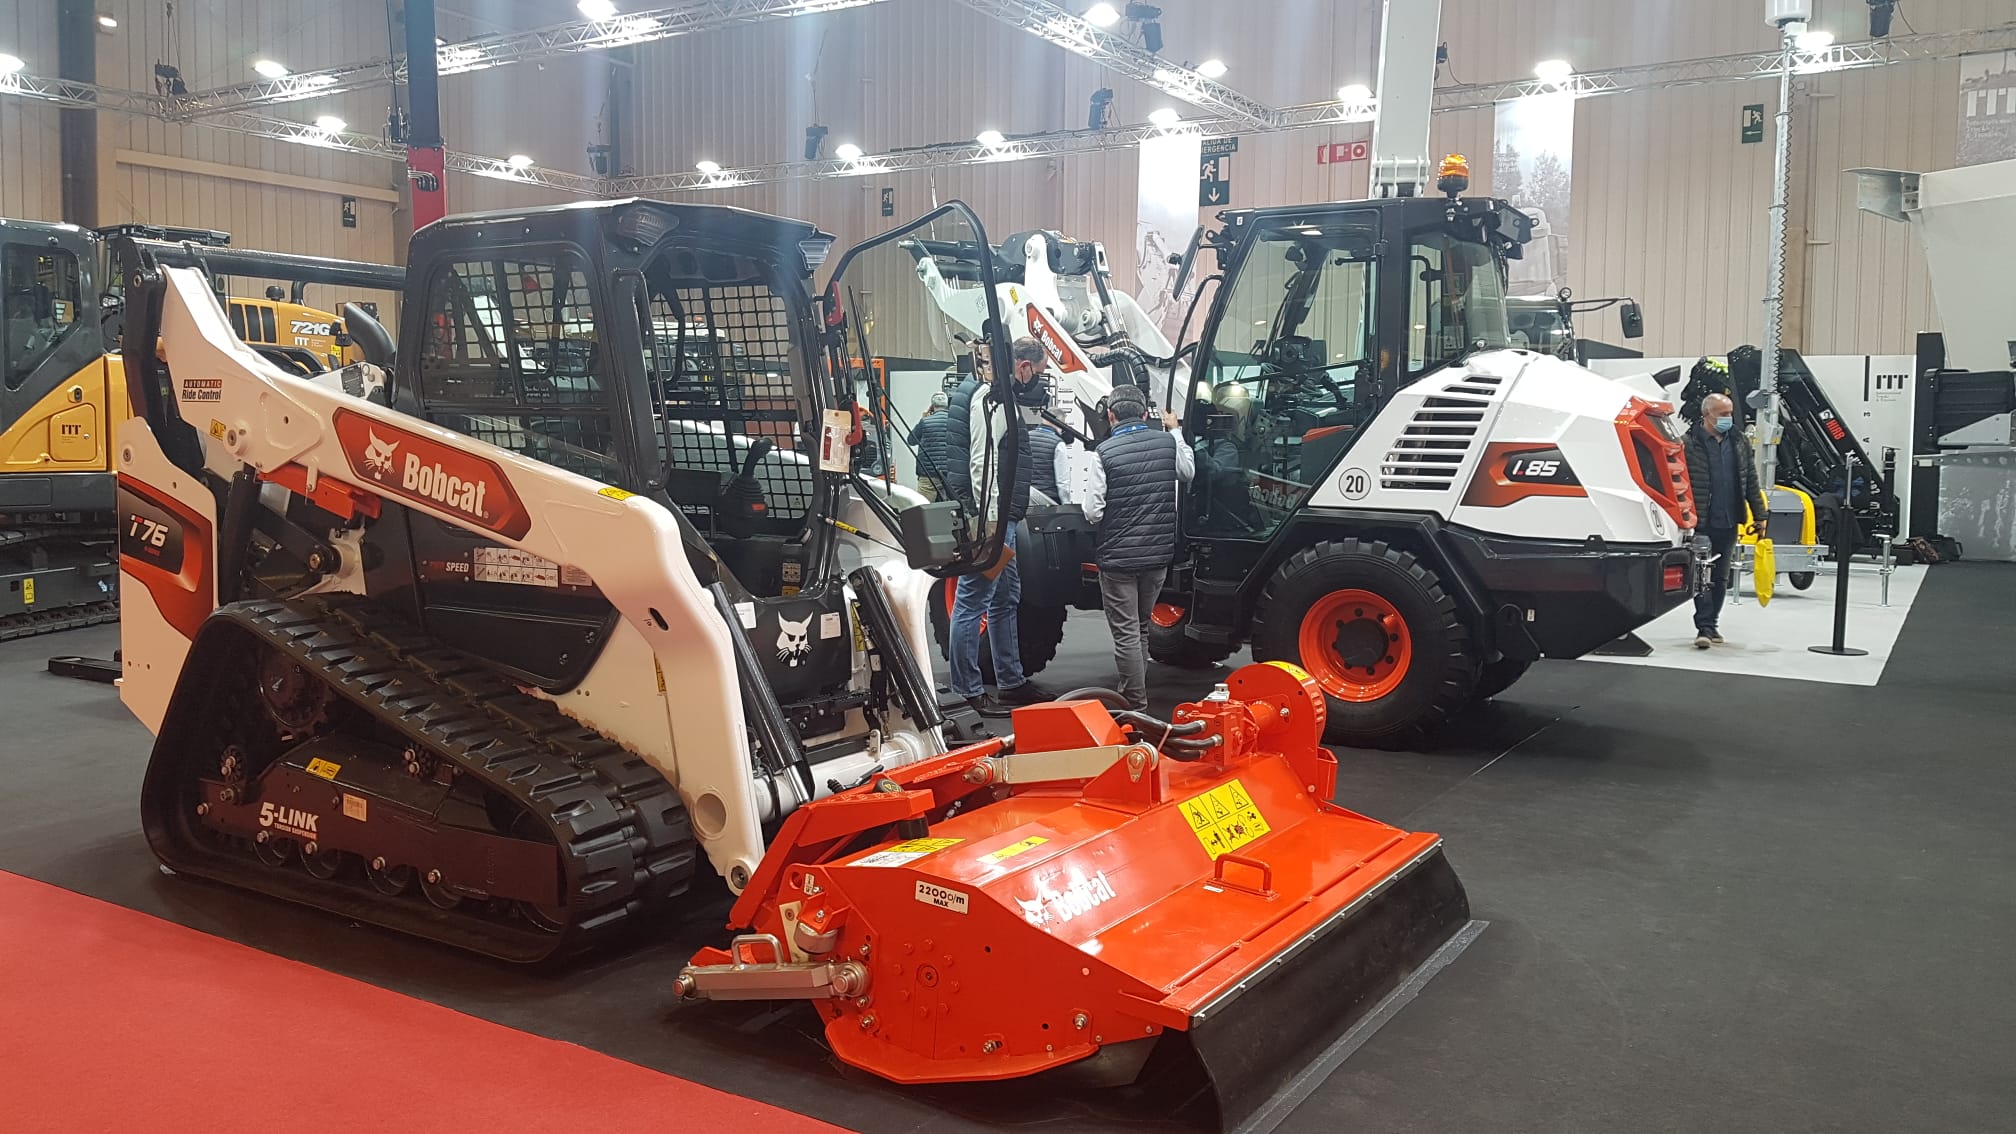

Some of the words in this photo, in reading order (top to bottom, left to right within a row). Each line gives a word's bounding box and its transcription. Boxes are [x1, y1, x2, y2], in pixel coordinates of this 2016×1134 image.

[290, 320, 331, 336] 721G
[1041, 330, 1063, 362] Bobcat
[183, 379, 222, 388] AUTOMATIC
[182, 389, 197, 400] Ride
[197, 389, 222, 401] Control
[1825, 419, 1846, 441] HIAB
[402, 452, 486, 518] Bobcat
[1346, 475, 1364, 493] 20
[130, 514, 169, 548] T76
[446, 563, 469, 573] SPEED
[259, 802, 319, 832] 5-LINK
[933, 897, 949, 908] MAX
